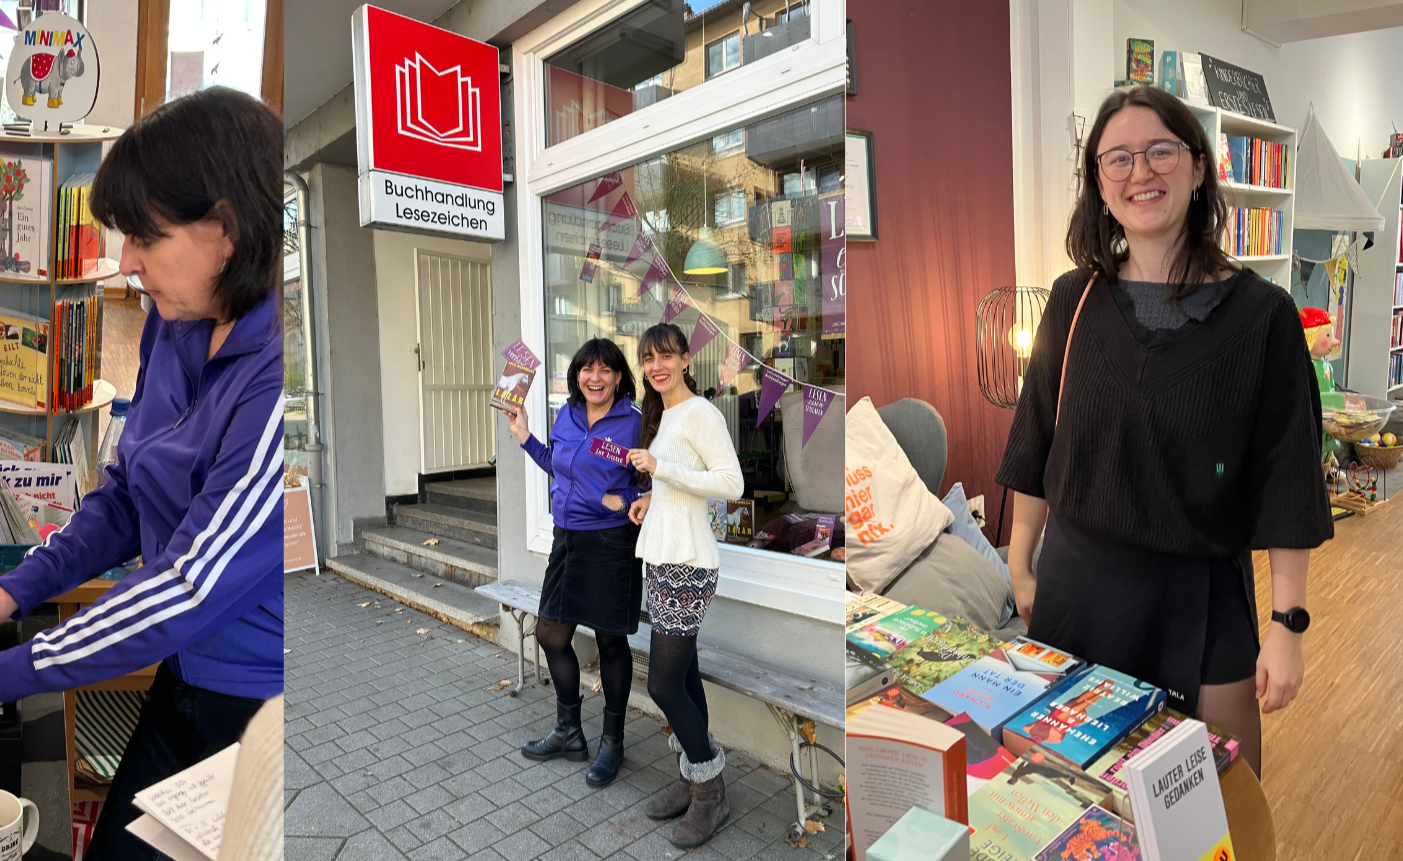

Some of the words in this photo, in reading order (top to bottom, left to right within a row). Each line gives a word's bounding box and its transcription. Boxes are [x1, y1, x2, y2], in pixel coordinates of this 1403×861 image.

[24, 29, 85, 49] MINIMAX
[385, 179, 495, 215] Buchhandlung
[17, 212, 29, 222] Ein
[395, 203, 488, 231] Lesezeichen
[16, 223, 35, 232] gutes
[16, 233, 31, 243] Jahr
[4, 342, 20, 352] EILT
[512, 341, 535, 368] LESEN
[595, 448, 605, 457] ist
[606, 452, 624, 464] bunt
[601, 441, 622, 455] LESEN
[14, 477, 32, 488] zu
[36, 473, 63, 487] mir
[33, 491, 56, 500] nicht
[848, 503, 875, 530] gar
[857, 522, 894, 547] nix.
[971, 672, 1001, 687] MANN
[983, 668, 1002, 679] TAT
[1004, 676, 1026, 689] DER
[965, 687, 995, 702] RUSSO
[1003, 684, 1022, 697] EIN
[1082, 683, 1127, 706] BEATRIZ
[1088, 676, 1139, 701] WILLIAMS
[1168, 689, 1185, 701] TALA
[953, 690, 992, 710] RICHARD
[1049, 700, 1109, 731] LIEBHABER
[1030, 711, 1097, 746] EHEMÄNNER
[1100, 772, 1128, 790] orden
[1152, 764, 1183, 798] LAUTER
[1185, 746, 1207, 772] LEISE
[989, 791, 1005, 803] mit
[1164, 767, 1204, 810] GEDANKEN
[1010, 789, 1040, 811] Wellen
[1004, 802, 1037, 822] atmete
[1042, 809, 1061, 823] den
[985, 822, 1009, 841] Und
[995, 811, 1042, 845] Großvater
